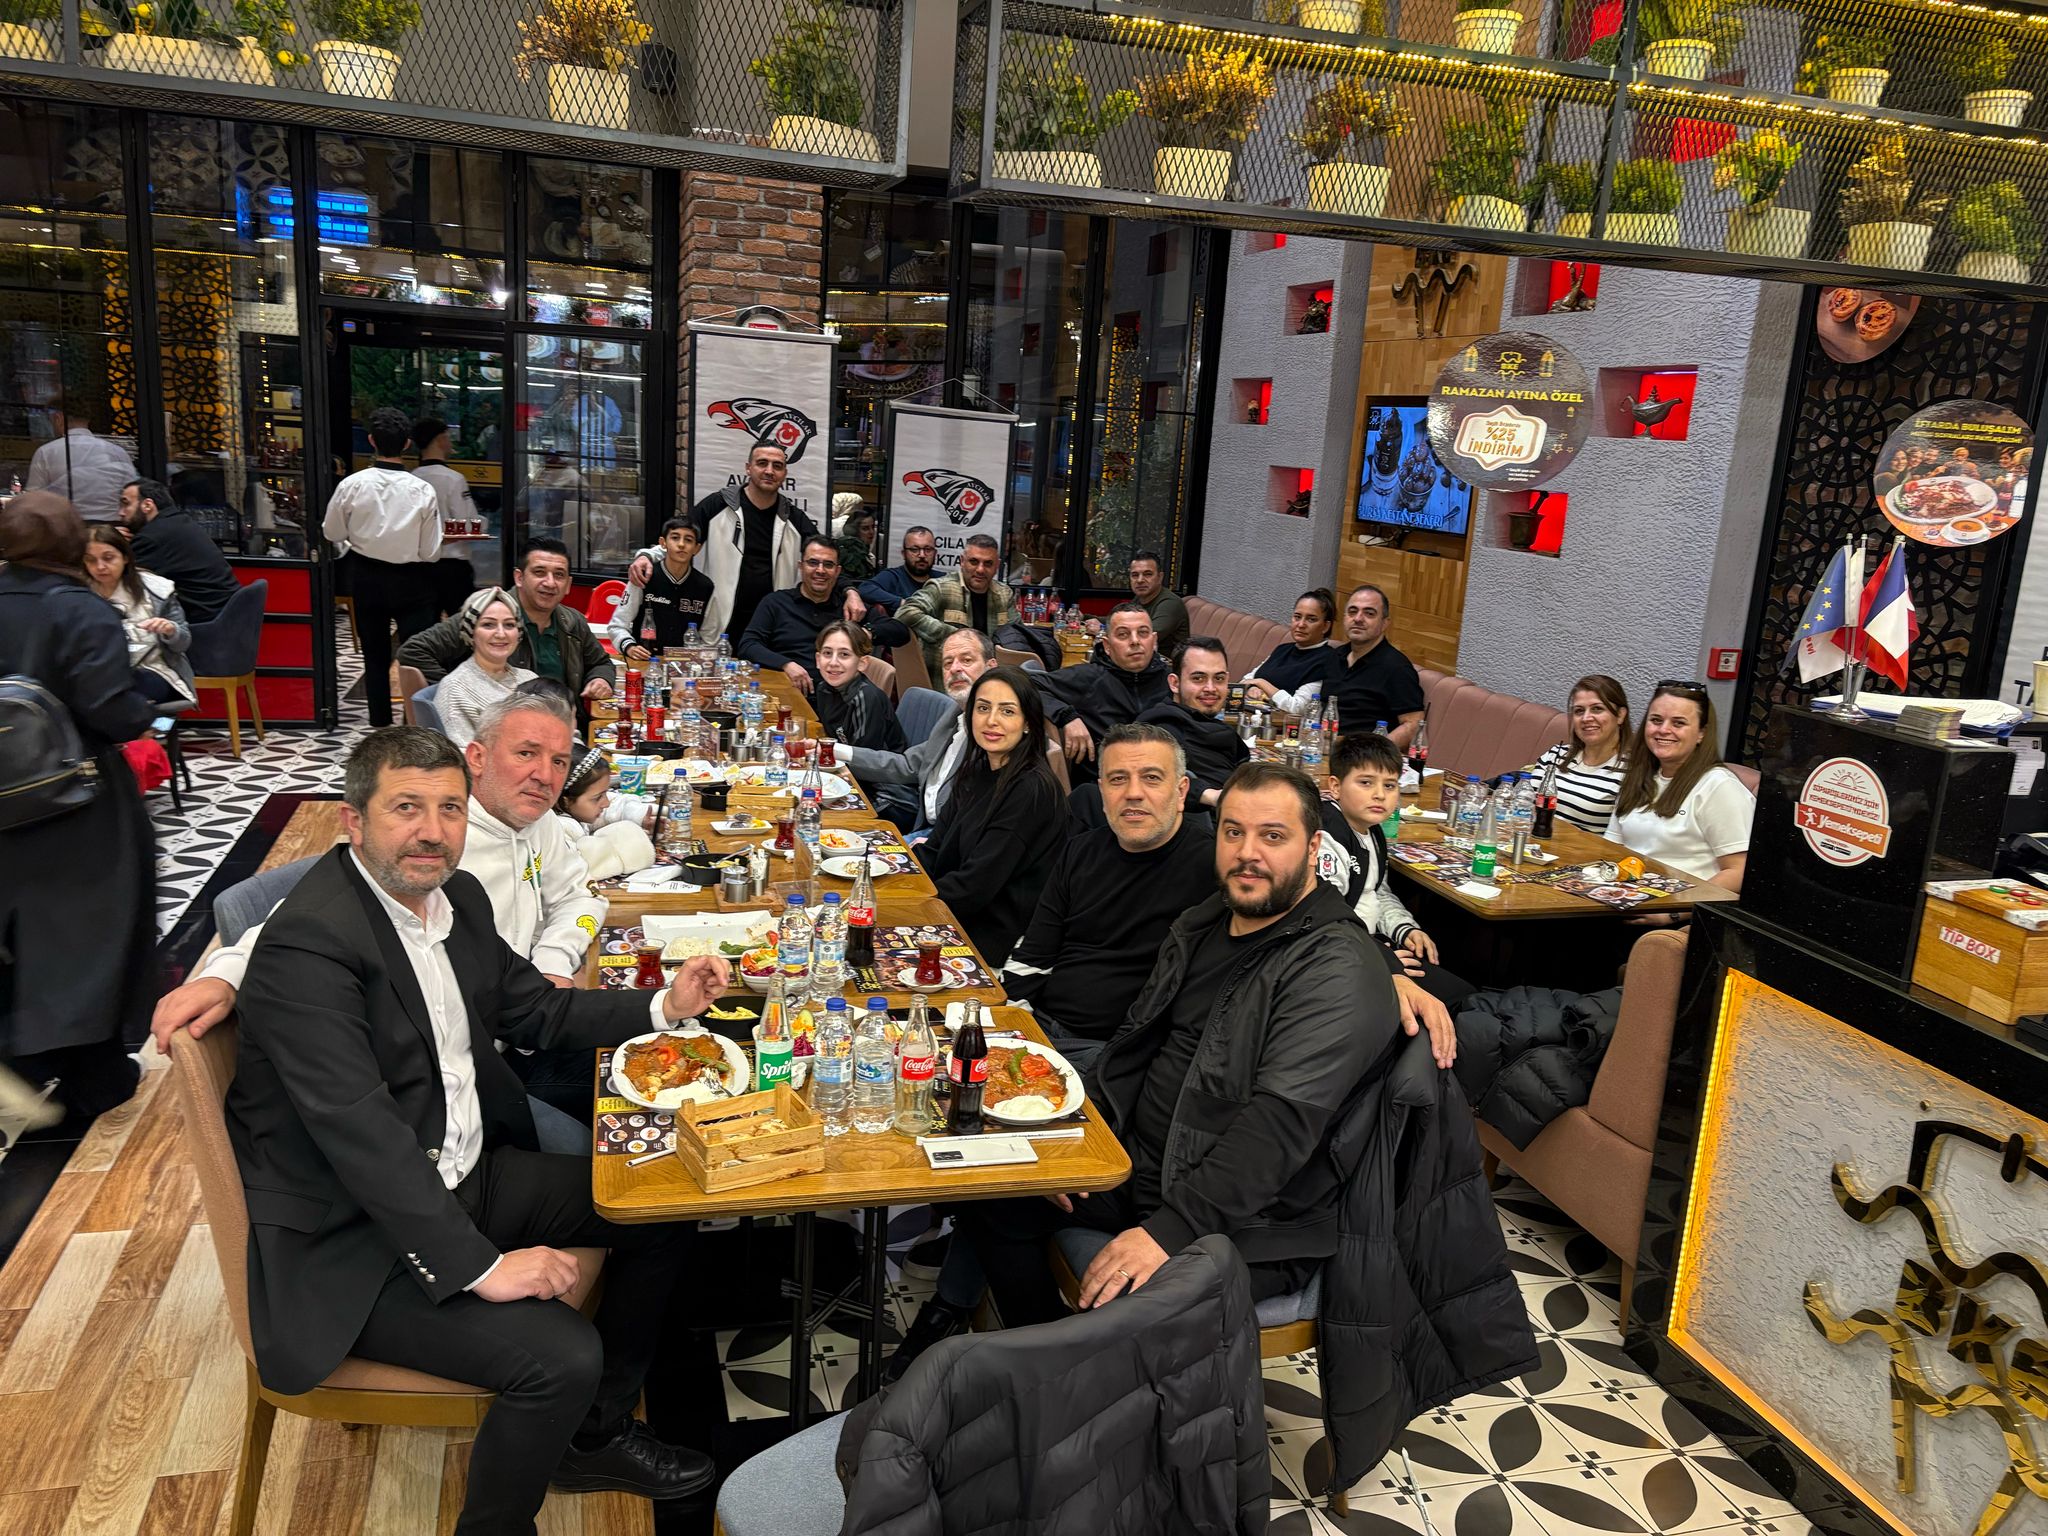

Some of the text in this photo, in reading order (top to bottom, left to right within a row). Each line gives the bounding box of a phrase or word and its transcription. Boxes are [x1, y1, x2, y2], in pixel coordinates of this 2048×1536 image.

[1441, 386, 1584, 403] RAMAZAN AYINA ÖZEL
[1485, 426, 1517, 442] %25
[1467, 438, 1525, 457] İNDİRİM
[948, 505, 970, 526] 2010
[1943, 928, 1995, 961] TIP BOX
[760, 1060, 792, 1079] Sprit
